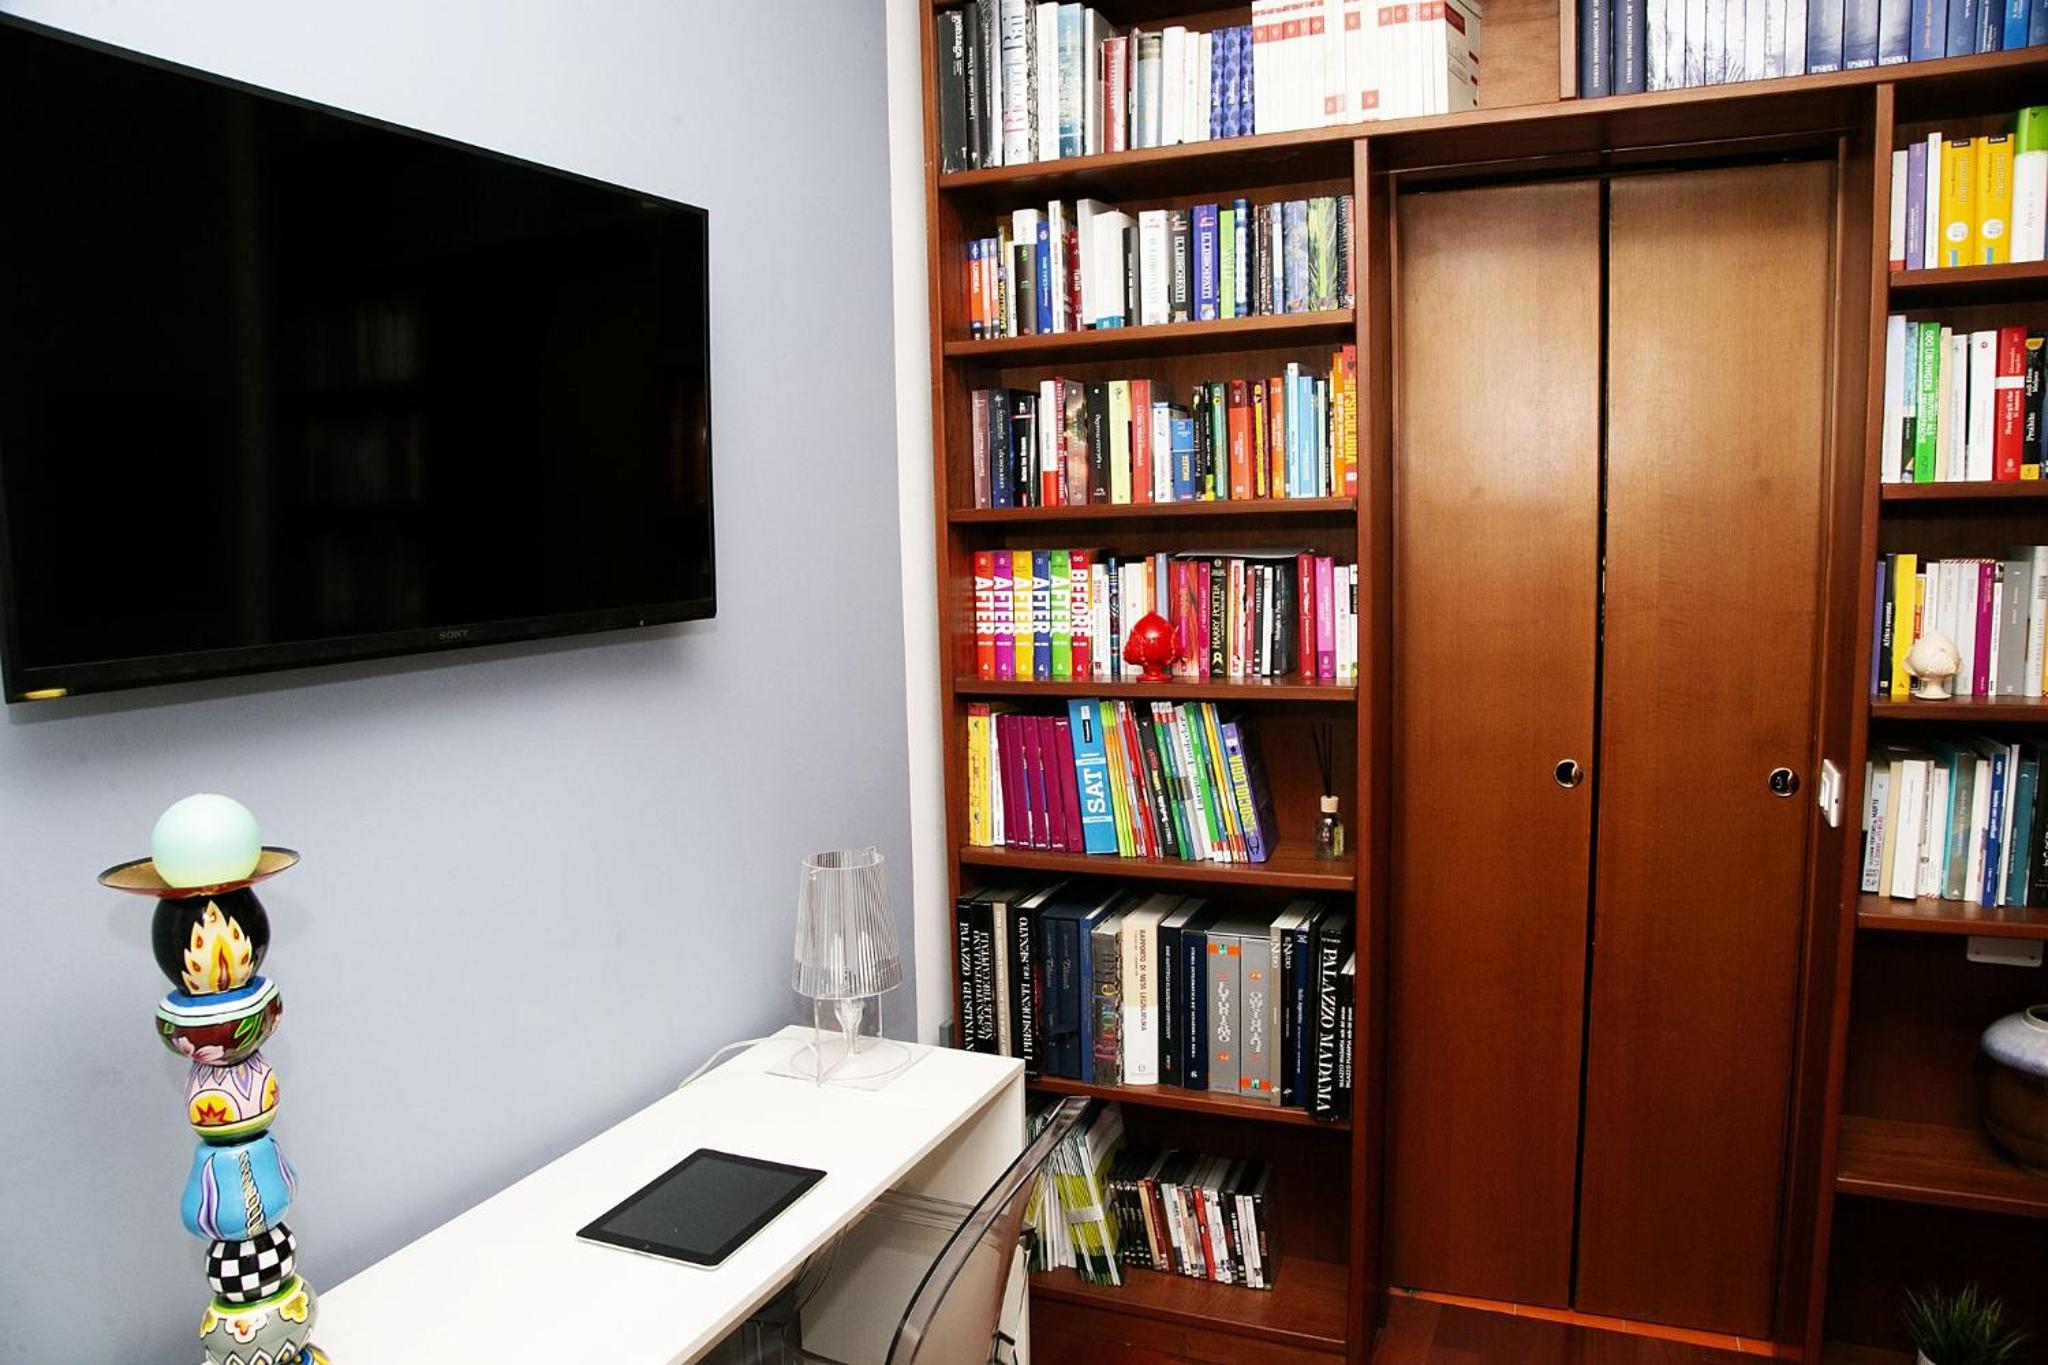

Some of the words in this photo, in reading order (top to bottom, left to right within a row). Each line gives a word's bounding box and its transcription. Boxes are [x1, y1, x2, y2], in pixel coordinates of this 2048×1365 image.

[1925, 330, 1934, 347] 600
[1924, 348, 1934, 391] ÜBUNGEN
[1344, 391, 1357, 464] PSICOLOGIA
[975, 575, 994, 634] AFTER
[994, 576, 1014, 634] AFTER
[1013, 576, 1033, 635] AFTER
[1033, 577, 1050, 634] AFTER
[1051, 576, 1071, 636] AFTER
[1071, 569, 1093, 636] BEFORE
[1212, 584, 1221, 617] POTTER
[1212, 618, 1221, 649] HARRY
[1084, 768, 1106, 814] SAT
[960, 922, 971, 977] PALAZZO
[972, 930, 983, 985] ITALIANO
[980, 931, 990, 980] CAPITALI
[1018, 916, 1030, 963] SENATO
[1139, 929, 1147, 962] RAPPORTO
[1282, 943, 1293, 969] NUDO
[982, 981, 992, 1002] TRE
[1140, 991, 1149, 1031] LEGISLATURA
[1320, 948, 1338, 1028] PALAZZO
[962, 981, 976, 1051] GIUSTINIAN
[982, 1004, 994, 1040] NELLE
[1020, 983, 1033, 1053] PRESIDENTI
[1316, 1032, 1334, 1112] MADAMA
